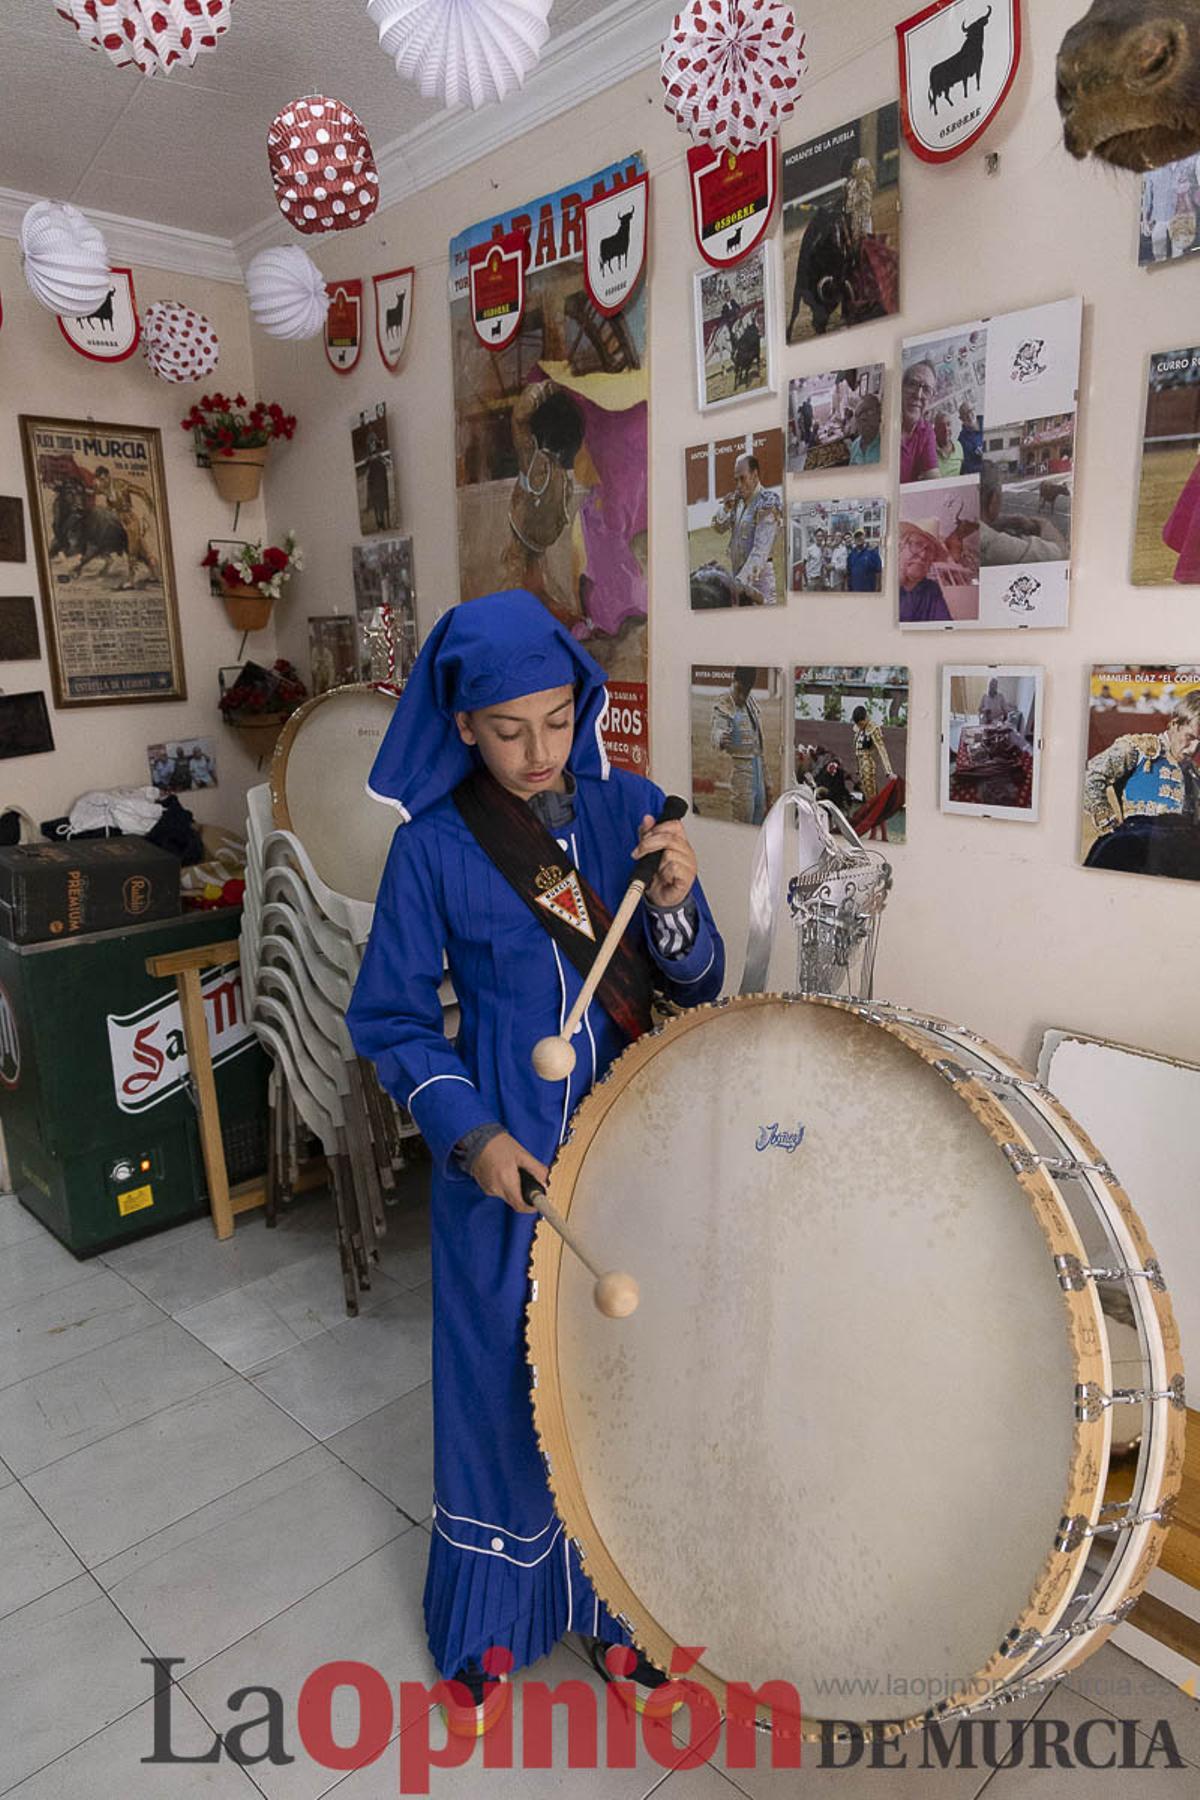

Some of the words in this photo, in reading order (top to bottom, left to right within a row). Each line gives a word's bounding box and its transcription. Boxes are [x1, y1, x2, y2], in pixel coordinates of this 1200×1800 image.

[939, 107, 981, 138] OSBORNE
[714, 203, 756, 231] OSBORNE
[1157, 359, 1189, 372] CURRO
[83, 438, 147, 459] MURCIA
[1099, 674, 1132, 683] MANUEL
[600, 707, 642, 736] OROS
[67, 870, 81, 932] PREMIUM
